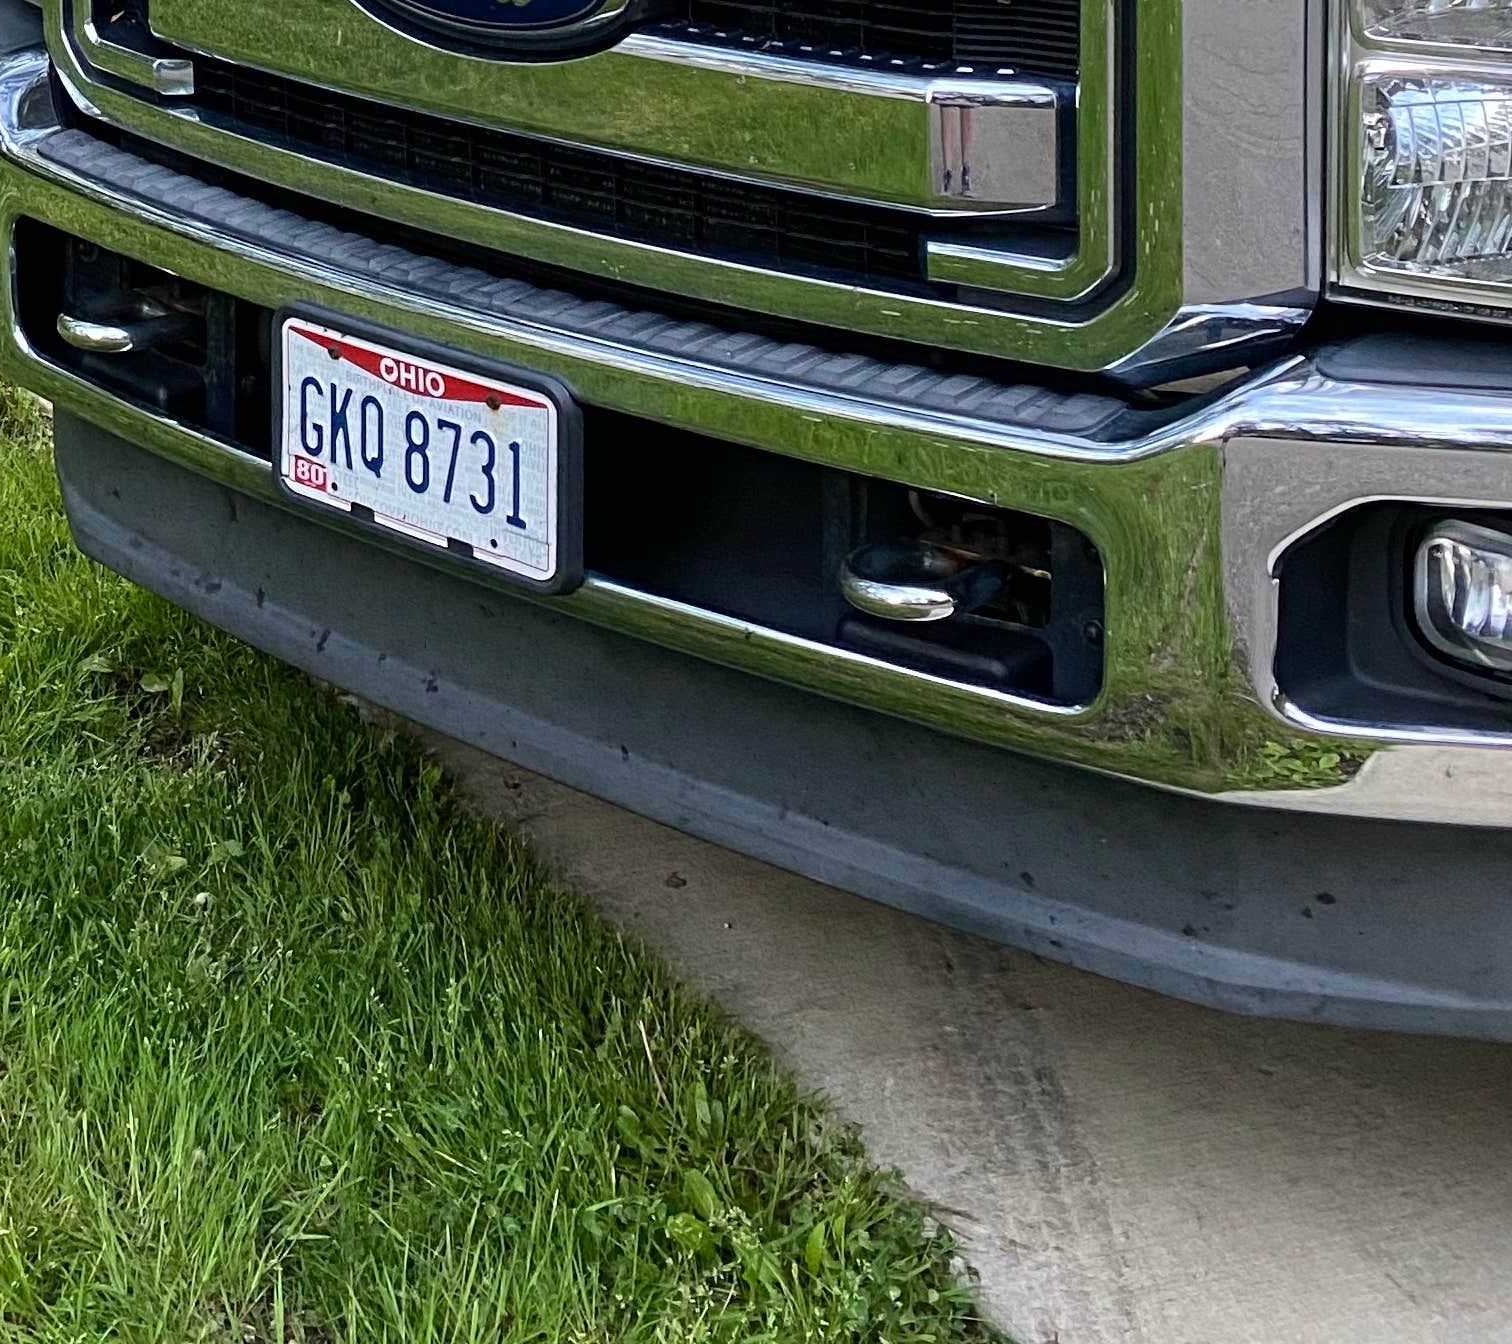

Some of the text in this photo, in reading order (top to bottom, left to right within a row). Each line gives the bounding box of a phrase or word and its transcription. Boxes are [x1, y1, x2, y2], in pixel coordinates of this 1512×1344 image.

[379, 357, 446, 397] OHIO
[429, 399, 482, 422] AVIATION
[300, 376, 384, 478] GKQ
[405, 410, 527, 530] 8731
[296, 459, 324, 486] 80
